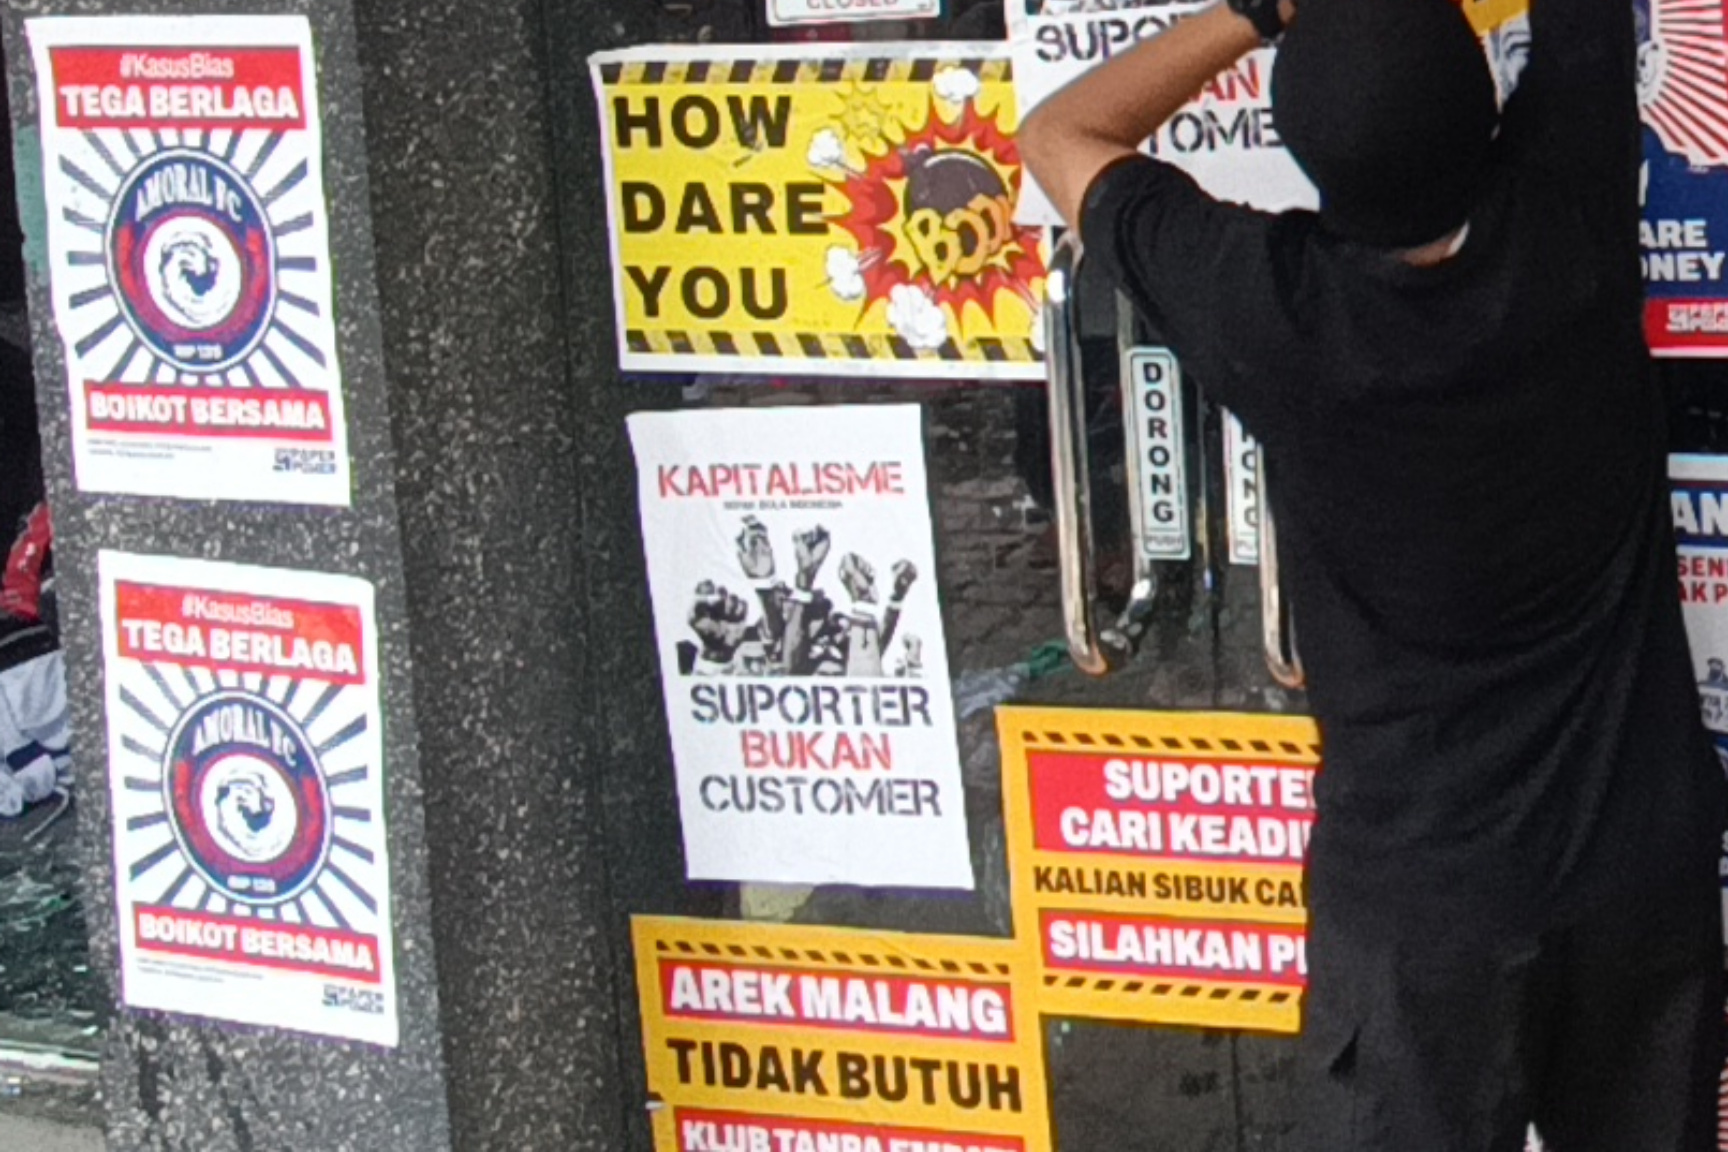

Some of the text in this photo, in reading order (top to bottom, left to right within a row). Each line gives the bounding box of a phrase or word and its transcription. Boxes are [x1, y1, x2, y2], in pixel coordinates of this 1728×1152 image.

[118, 52, 235, 79] #KasusBias
[59, 85, 301, 120] TEGA BERLAGA
[613, 94, 792, 148] HOW
[621, 181, 829, 235] DARE
[626, 264, 788, 320] YOU
[90, 391, 326, 430] BOIKOT BERSAMA
[1142, 361, 1175, 524] DORONG
[657, 461, 905, 499] KAPITALISME
[181, 594, 294, 629] #KasusBias
[122, 619, 359, 675] TEGA BERLAGA
[690, 684, 933, 727] SUPORTER
[740, 729, 893, 771] BUKAN
[699, 774, 942, 817] CUSTOMER
[1104, 759, 1317, 810] SUPORTE
[1060, 807, 1313, 858] CARI KEADI
[1034, 865, 1147, 898] KALIAN
[1152, 873, 1250, 904] SIBUK
[138, 912, 237, 952] BOIKOT
[240, 927, 375, 971] BERSAMA
[1050, 920, 1262, 972] SILAHKAN
[671, 966, 1008, 1035] AREK MALANG
[666, 1037, 1023, 1113] TIDAK BUTUH
[682, 1119, 771, 1152] KLUB
